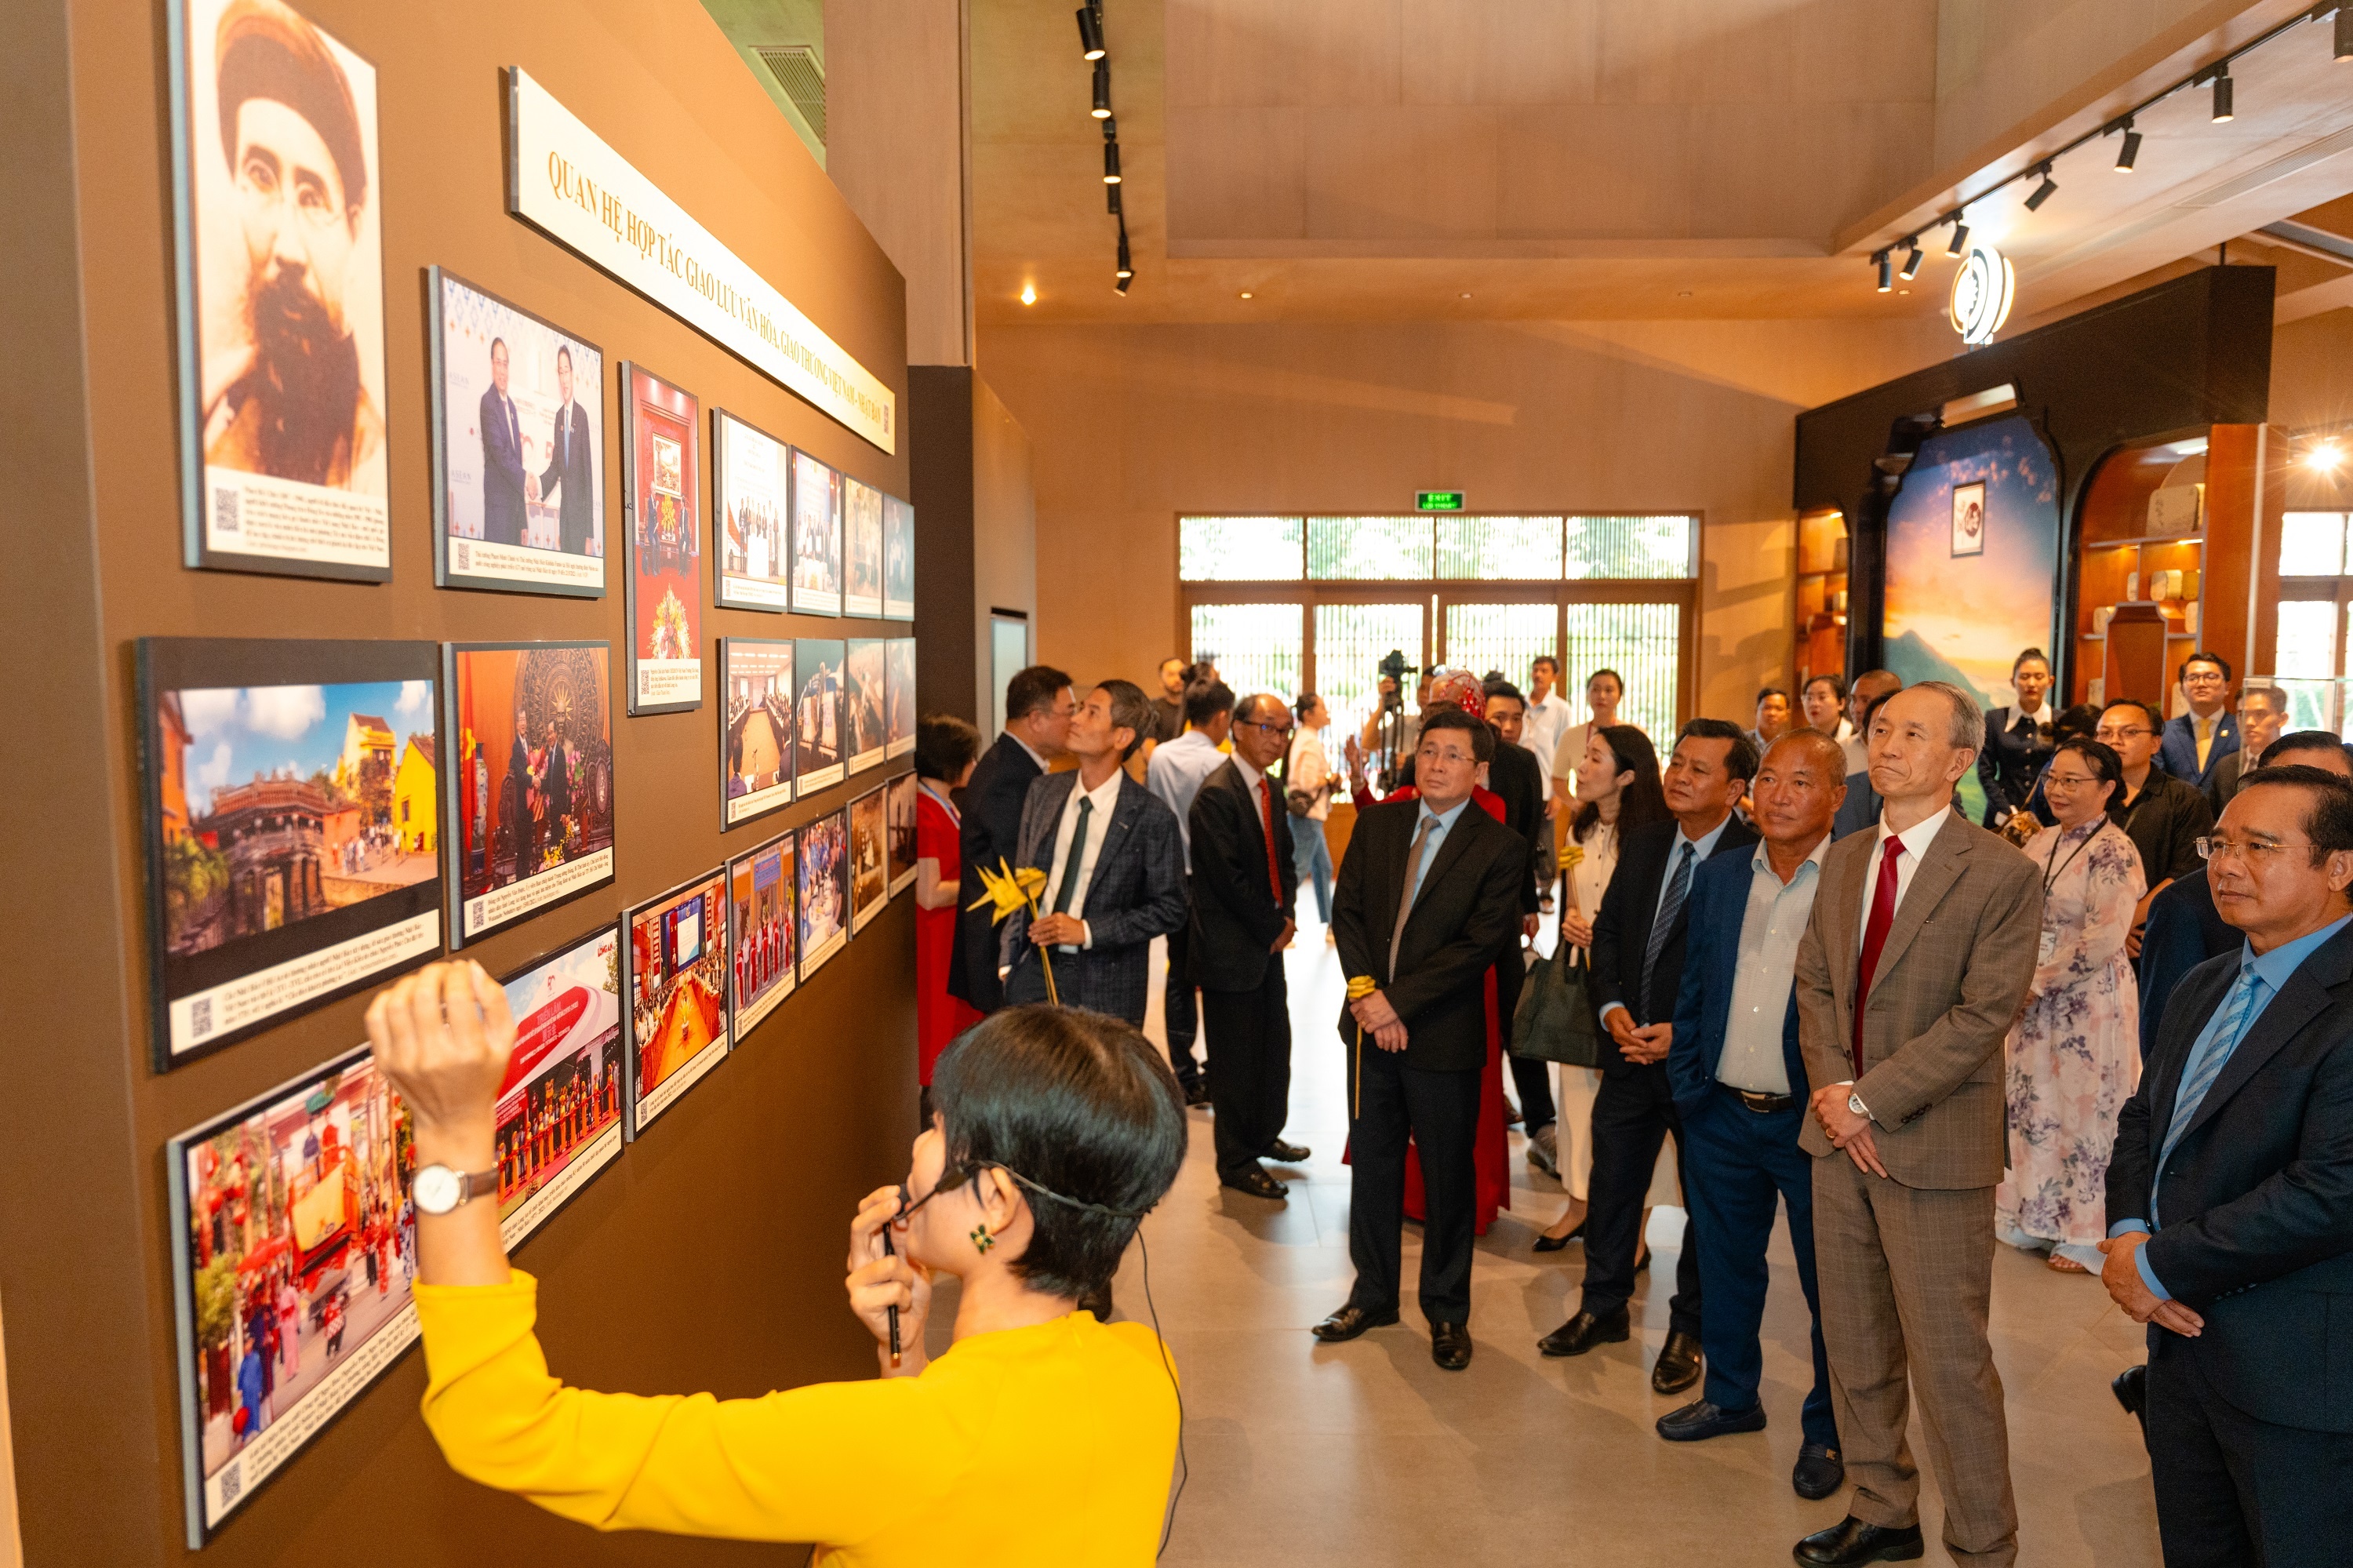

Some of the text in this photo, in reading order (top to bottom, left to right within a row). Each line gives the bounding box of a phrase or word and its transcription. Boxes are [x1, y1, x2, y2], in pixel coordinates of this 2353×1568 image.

[548, 151, 597, 217] QUAN
[602, 190, 623, 243] HỆ
[627, 209, 656, 260] HỢP
[658, 233, 682, 278] TÁC
[686, 257, 715, 300] GIAO
[717, 279, 737, 318] LƯU
[740, 297, 758, 333] VĂN
[781, 330, 799, 363] GIAO
[801, 345, 827, 385] THƯƠNG
[828, 368, 842, 398] VIỆT
[842, 378, 855, 406] NAM
[858, 391, 871, 420] NHẬT
[871, 399, 881, 424] BẢN
